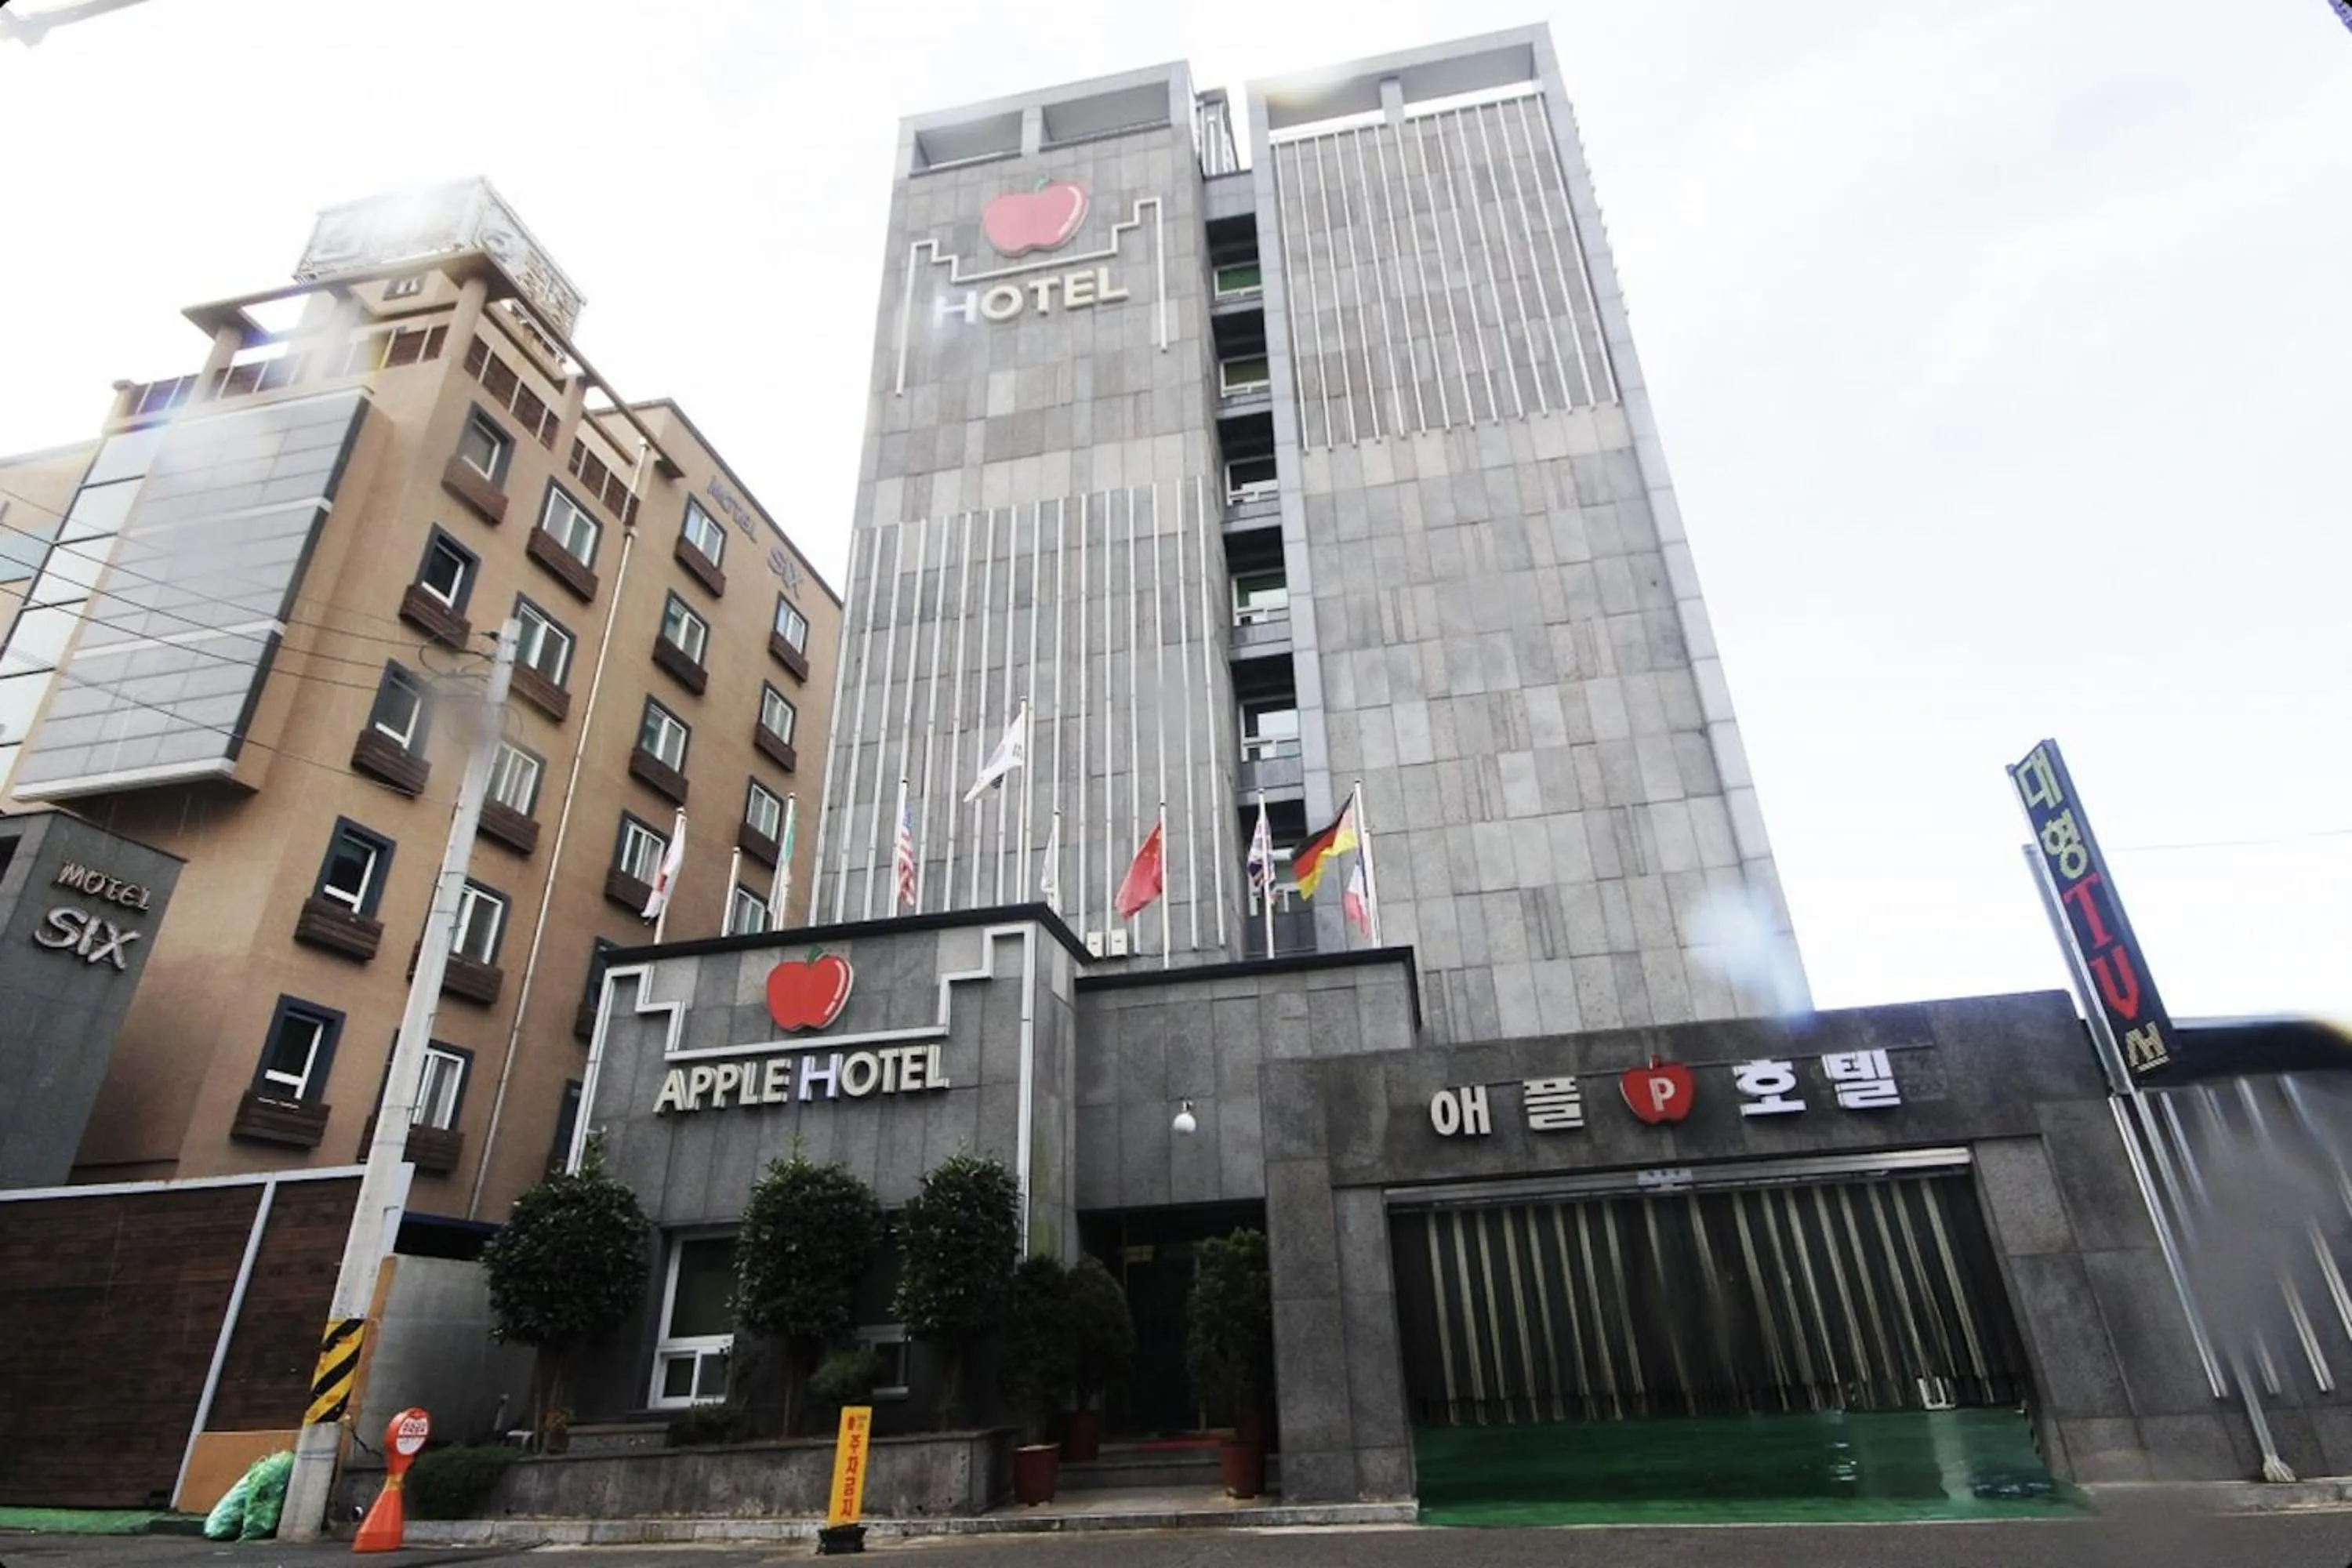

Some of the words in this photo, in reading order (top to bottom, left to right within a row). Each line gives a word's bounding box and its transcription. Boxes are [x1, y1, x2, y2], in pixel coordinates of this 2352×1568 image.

[933, 267, 1129, 329] HOTEL
[34, 906, 141, 970] SIX
[652, 1059, 792, 1114] APPLE
[798, 1045, 950, 1102] HOTEL
[1431, 1076, 1584, 1136] 애플
[1733, 1049, 1902, 1117] 호텔
